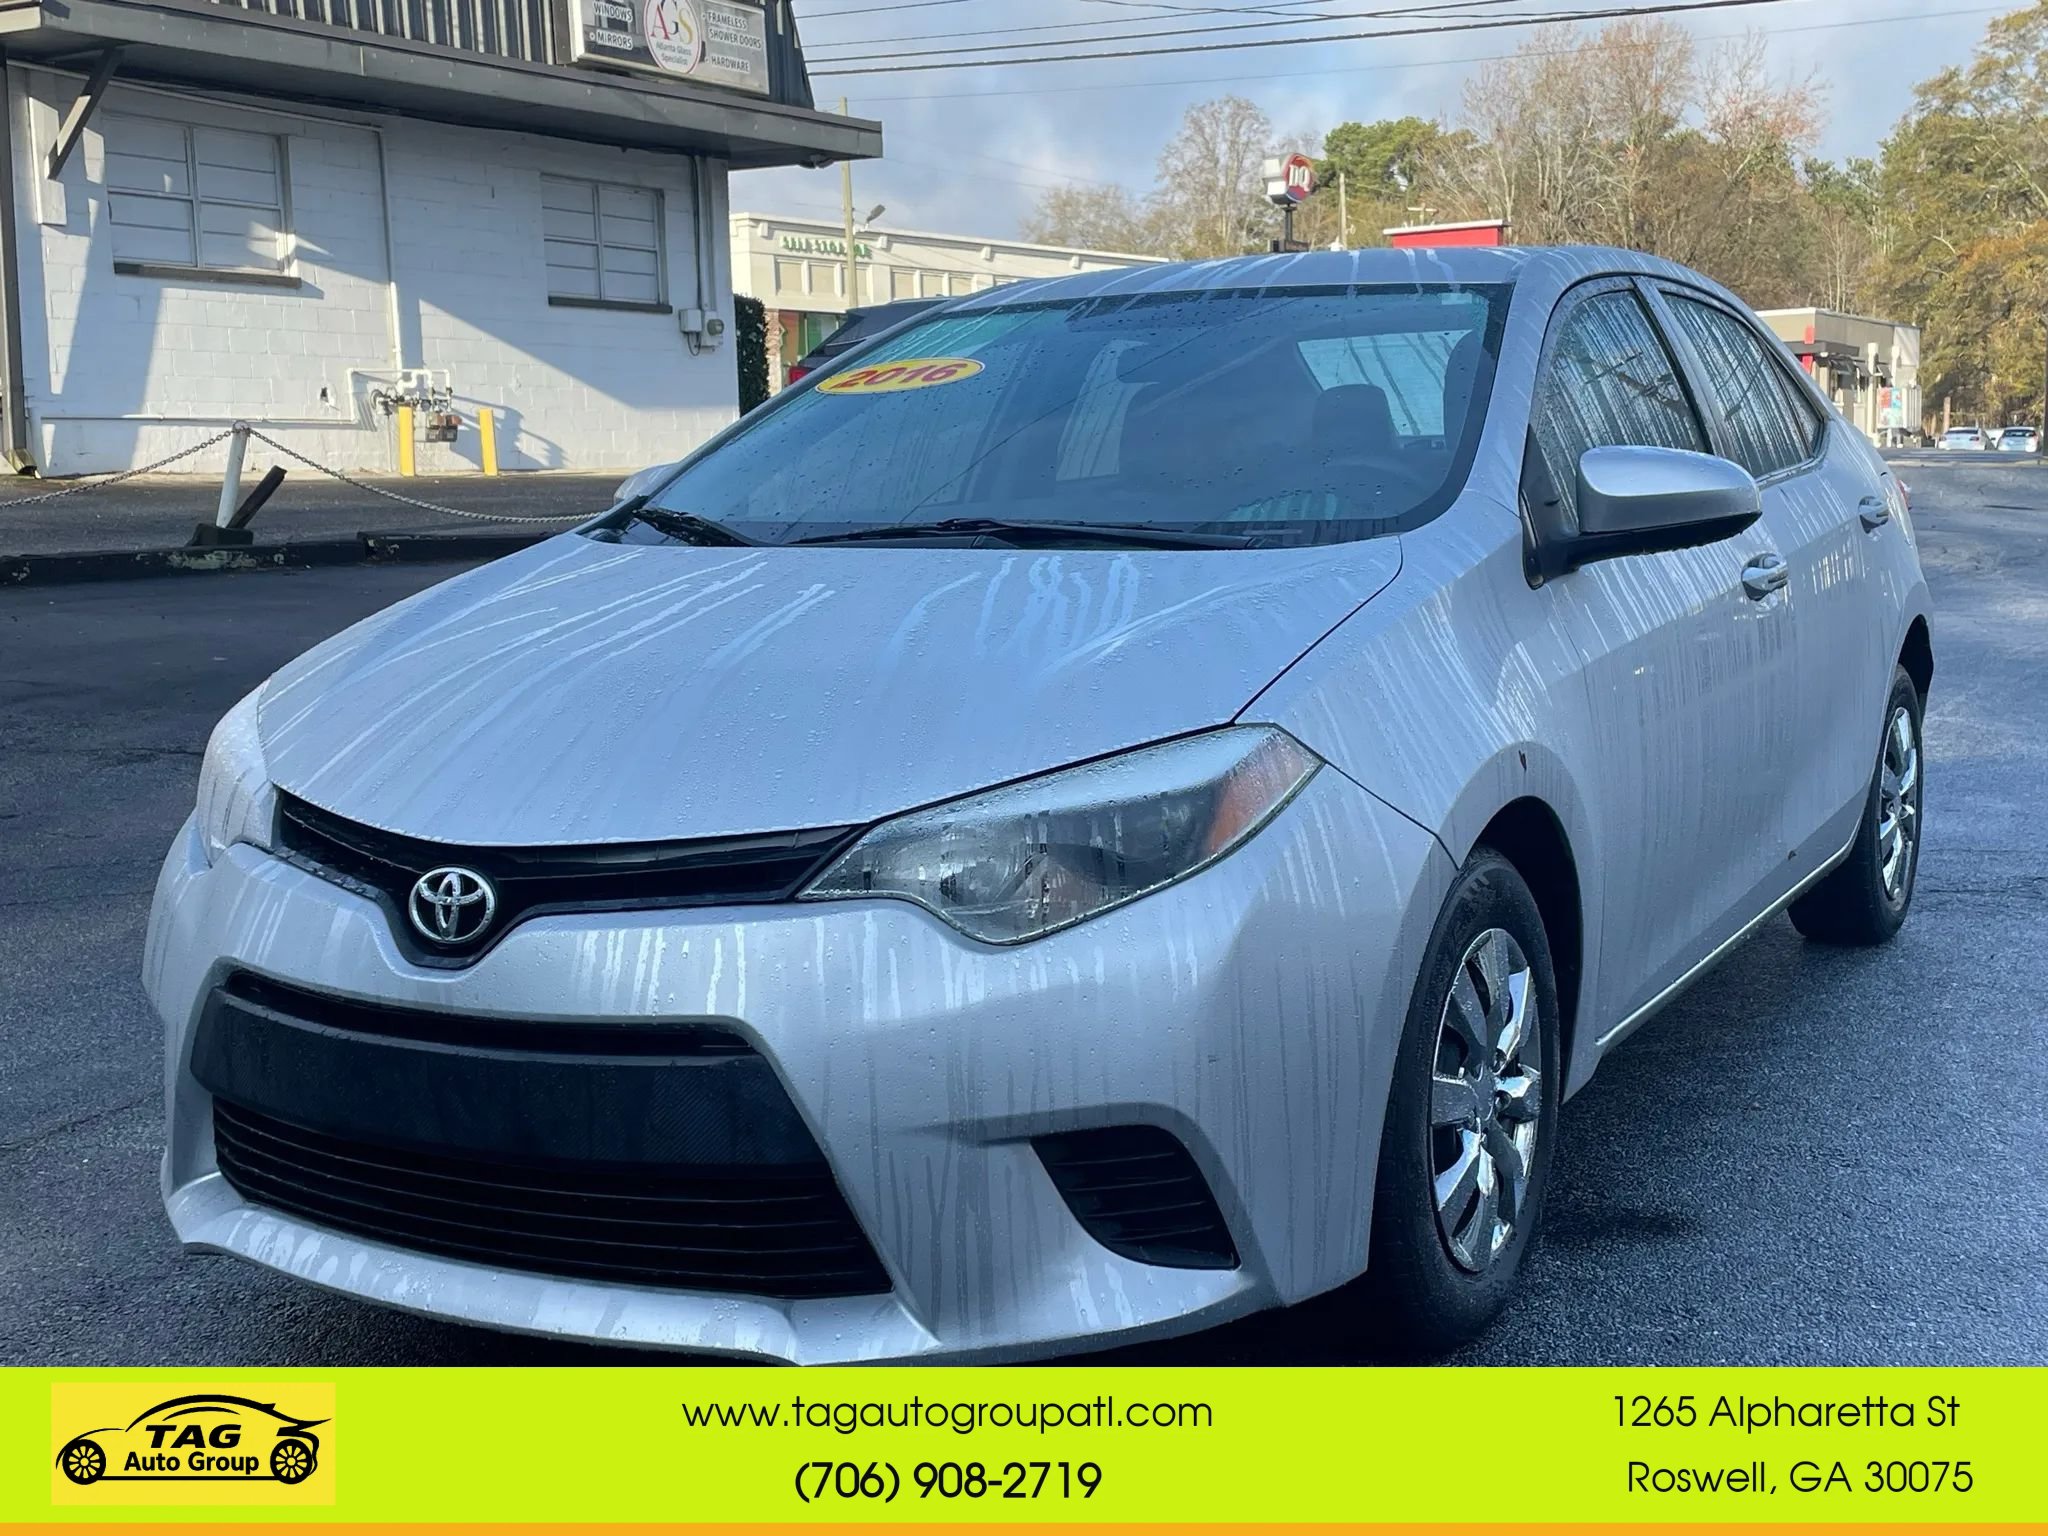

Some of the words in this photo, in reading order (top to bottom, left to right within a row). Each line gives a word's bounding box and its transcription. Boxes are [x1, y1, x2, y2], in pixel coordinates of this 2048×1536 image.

[593, 1, 632, 21] WINDOWS
[708, 11, 747, 30] FRAMELESS
[597, 31, 632, 49] MIRRORS
[709, 28, 738, 44] SHOWER
[739, 34, 761, 49] DOORS
[711, 56, 750, 72] HARDWARE
[1288, 164, 1310, 192] DQ
[829, 363, 968, 390] 2016
